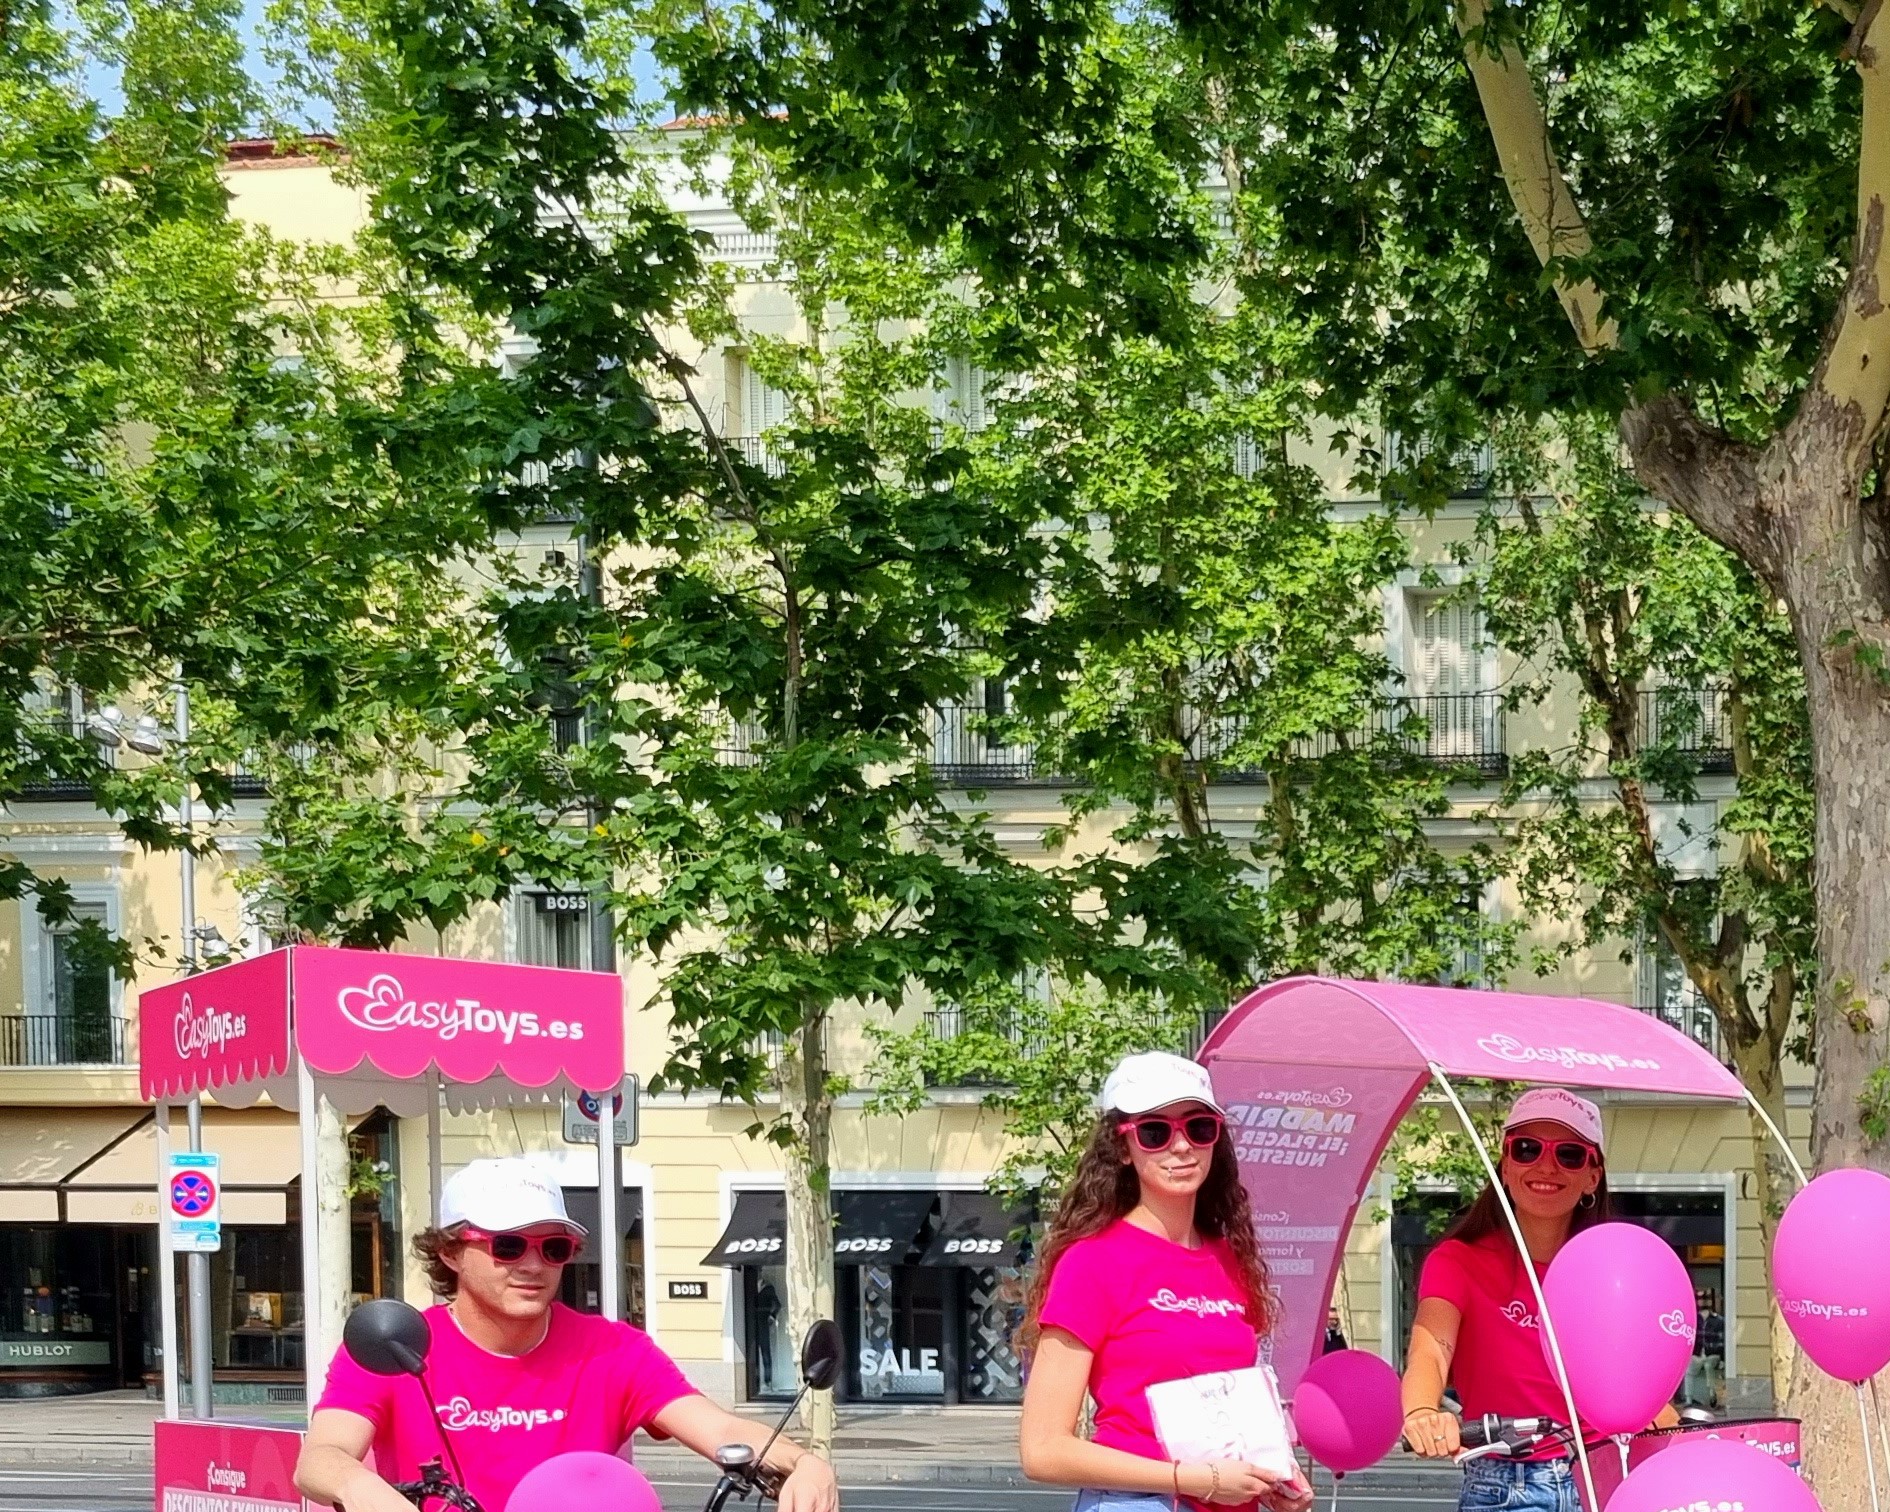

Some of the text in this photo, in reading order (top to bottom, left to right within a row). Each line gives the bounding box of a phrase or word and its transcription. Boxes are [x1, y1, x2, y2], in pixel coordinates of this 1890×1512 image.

[546, 896, 587, 910] BOSS
[337, 974, 584, 1044] EasyToys.es
[174, 991, 247, 1060] EasyToys.es
[725, 1236, 783, 1254] BOSS
[835, 1237, 893, 1253] BOSS
[944, 1238, 1004, 1254] BOSS
[673, 1284, 703, 1296] BOSS
[9, 1345, 73, 1357] HUBLOT
[860, 1347, 939, 1376] SALE
[207, 1461, 247, 1494] ¡Consigue
